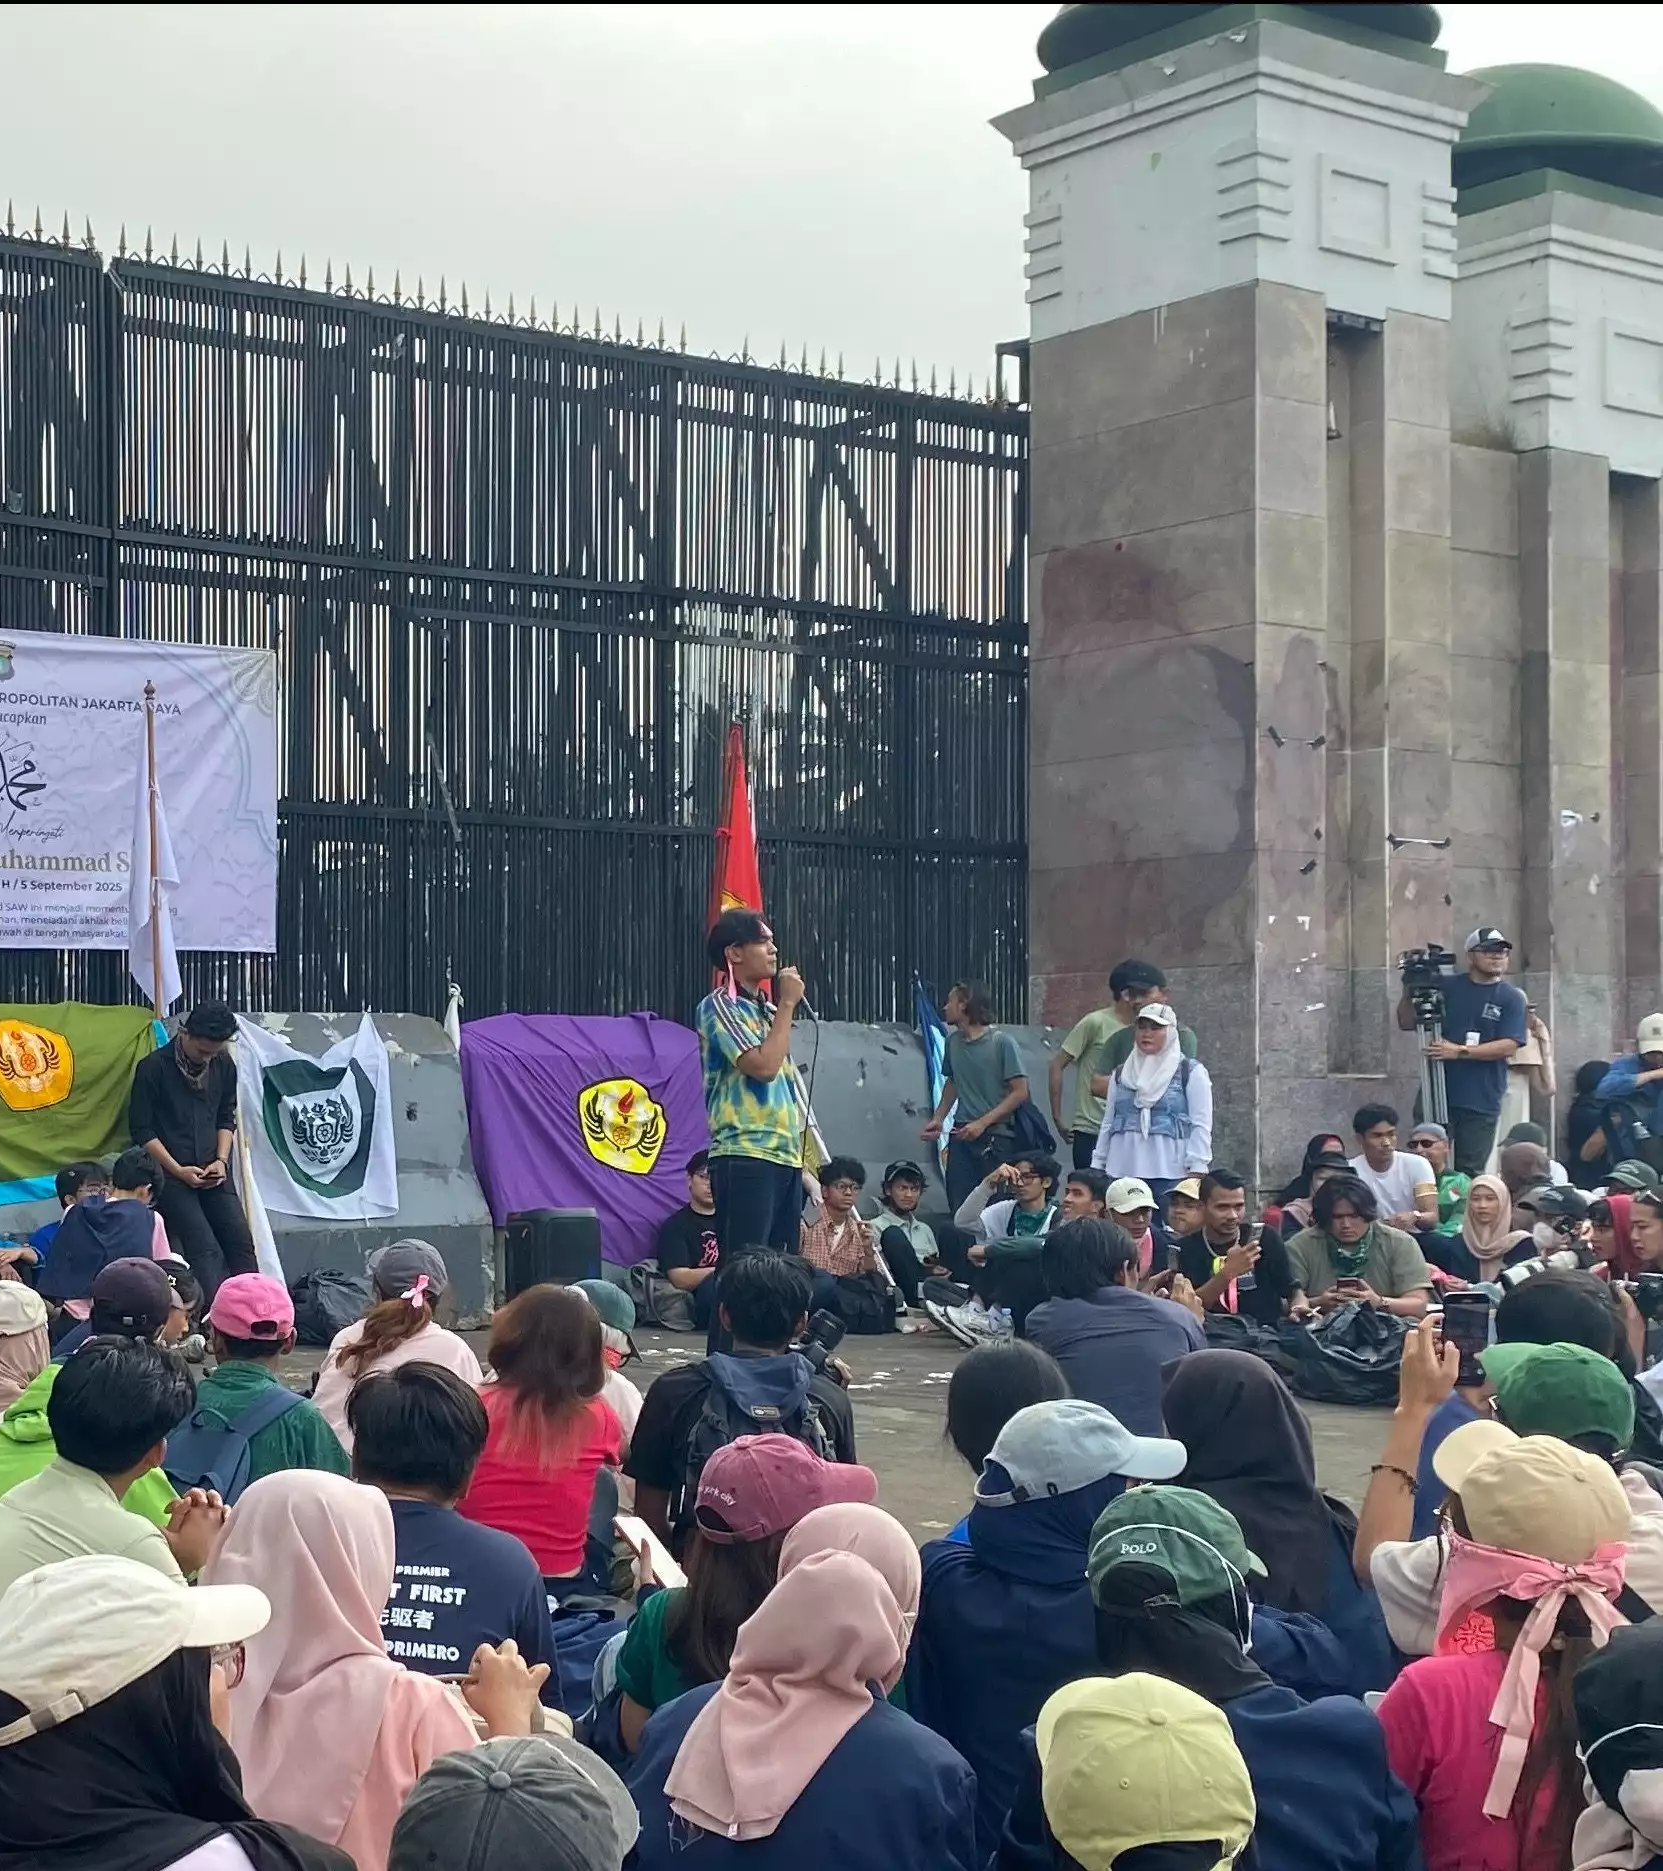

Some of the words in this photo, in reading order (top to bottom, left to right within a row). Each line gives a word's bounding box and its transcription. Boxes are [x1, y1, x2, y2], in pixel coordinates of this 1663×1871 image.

[81, 697, 142, 713] JAKARTA
[147, 701, 182, 716] AYA
[116, 850, 130, 873] S
[2, 879, 10, 889] H
[13, 879, 19, 890] /
[21, 881, 28, 890] 5
[30, 881, 93, 893] September
[96, 882, 123, 892] 2025
[5, 903, 28, 911] SAW
[30, 903, 42, 912] ini
[44, 904, 84, 915] menjadi
[86, 905, 129, 914] momentu
[79, 916, 109, 926] akhlak
[24, 928, 34, 938] di
[35, 929, 70, 939] tengah
[1120, 1542, 1157, 1554] POLO
[395, 1565, 450, 1577] PREMIER
[409, 1584, 467, 1606] FIRST
[384, 1640, 460, 1662] PRIMERO
